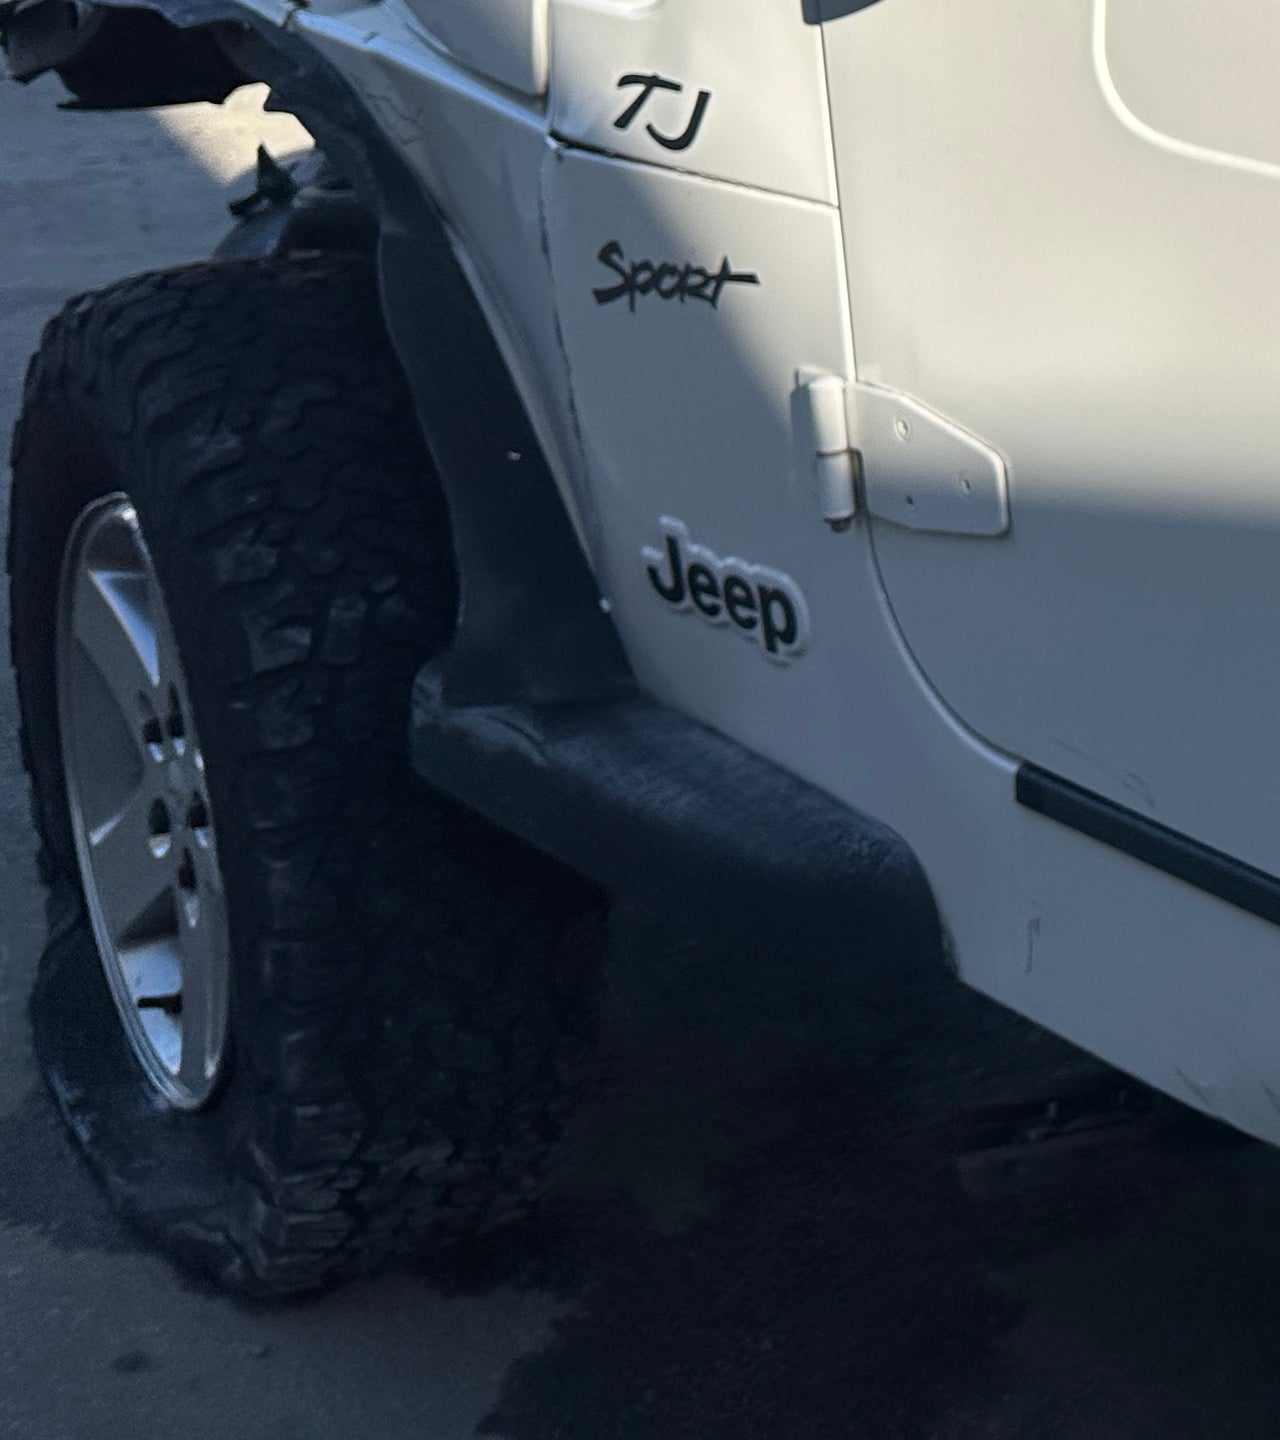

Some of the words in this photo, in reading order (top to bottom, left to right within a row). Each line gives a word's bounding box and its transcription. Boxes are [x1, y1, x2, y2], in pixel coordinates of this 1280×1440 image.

[613, 72, 711, 151] TJ
[592, 239, 760, 313] Sport
[646, 533, 799, 654] Jeep
